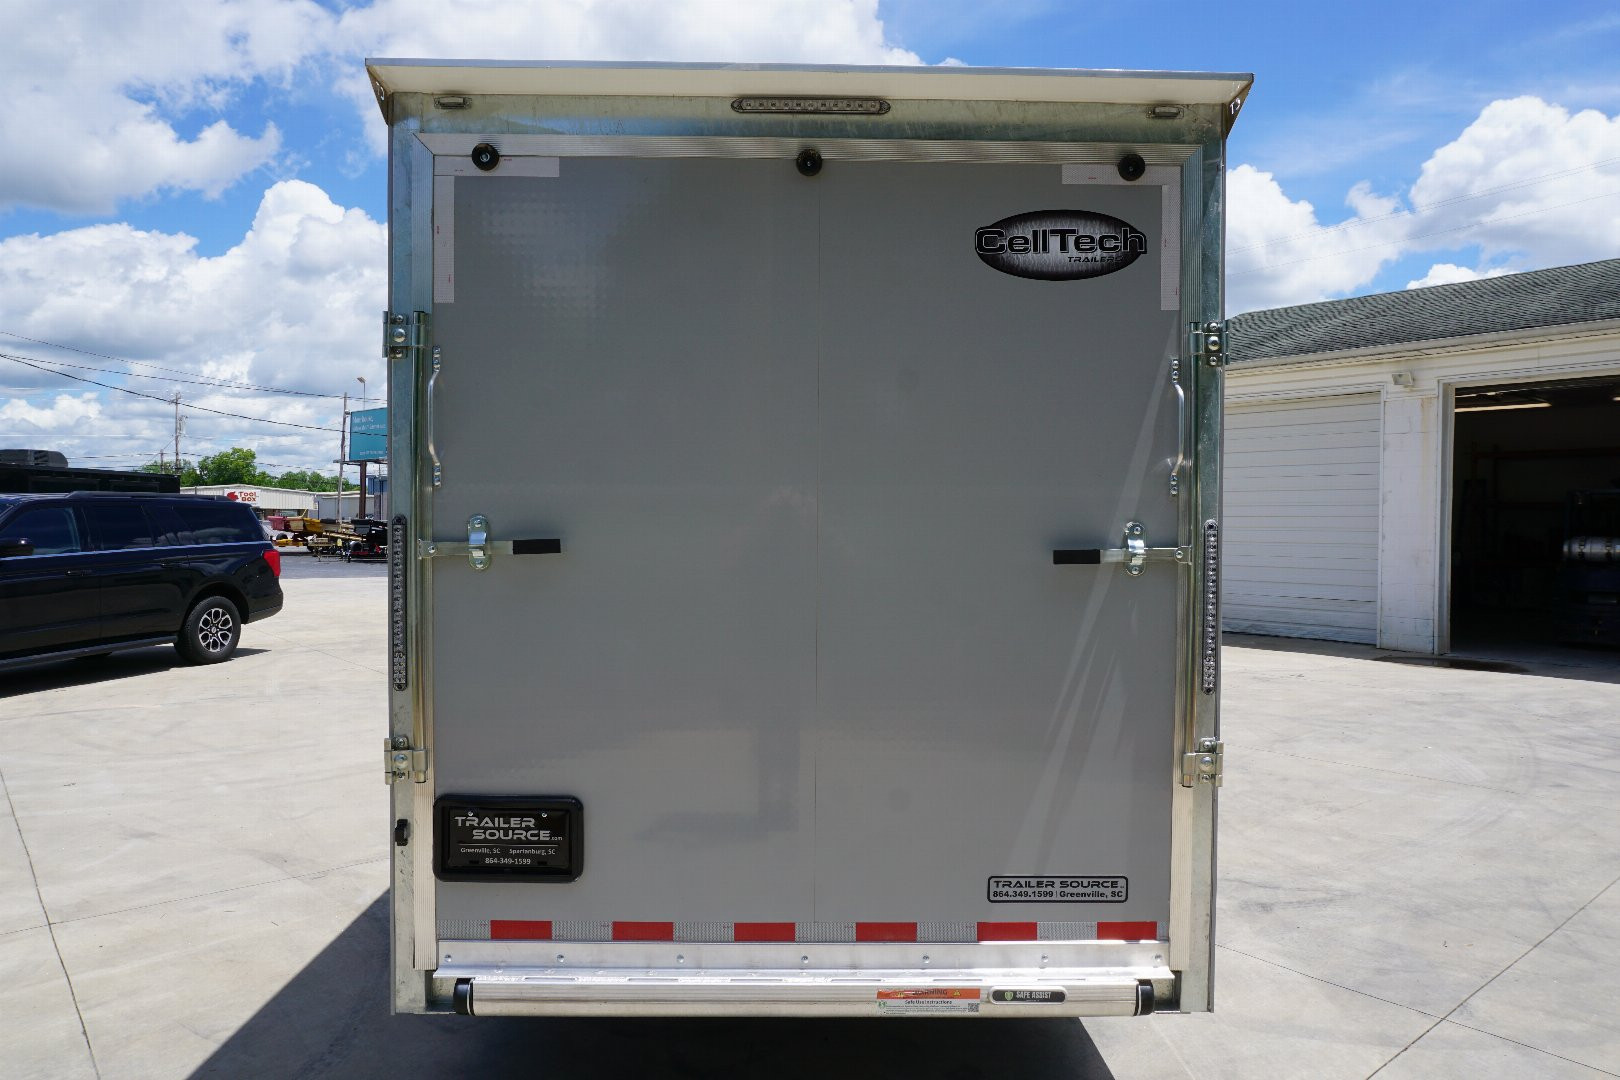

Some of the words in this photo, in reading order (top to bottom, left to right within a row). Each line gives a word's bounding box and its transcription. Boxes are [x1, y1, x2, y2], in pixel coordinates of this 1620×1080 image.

[975, 227, 1147, 254] CellTech
[454, 816, 535, 828] TRAILER
[485, 857, 531, 865] 864-349-1599
[993, 880, 1056, 889] TRAILER
[1059, 880, 1119, 889] SOURCE
[992, 890, 1054, 898] 864.349.1599
[1059, 890, 1108, 899] Greenville,
[1110, 890, 1123, 898] SC
[1015, 991, 1031, 999] SAFE
[1031, 991, 1051, 999] ASSIST
